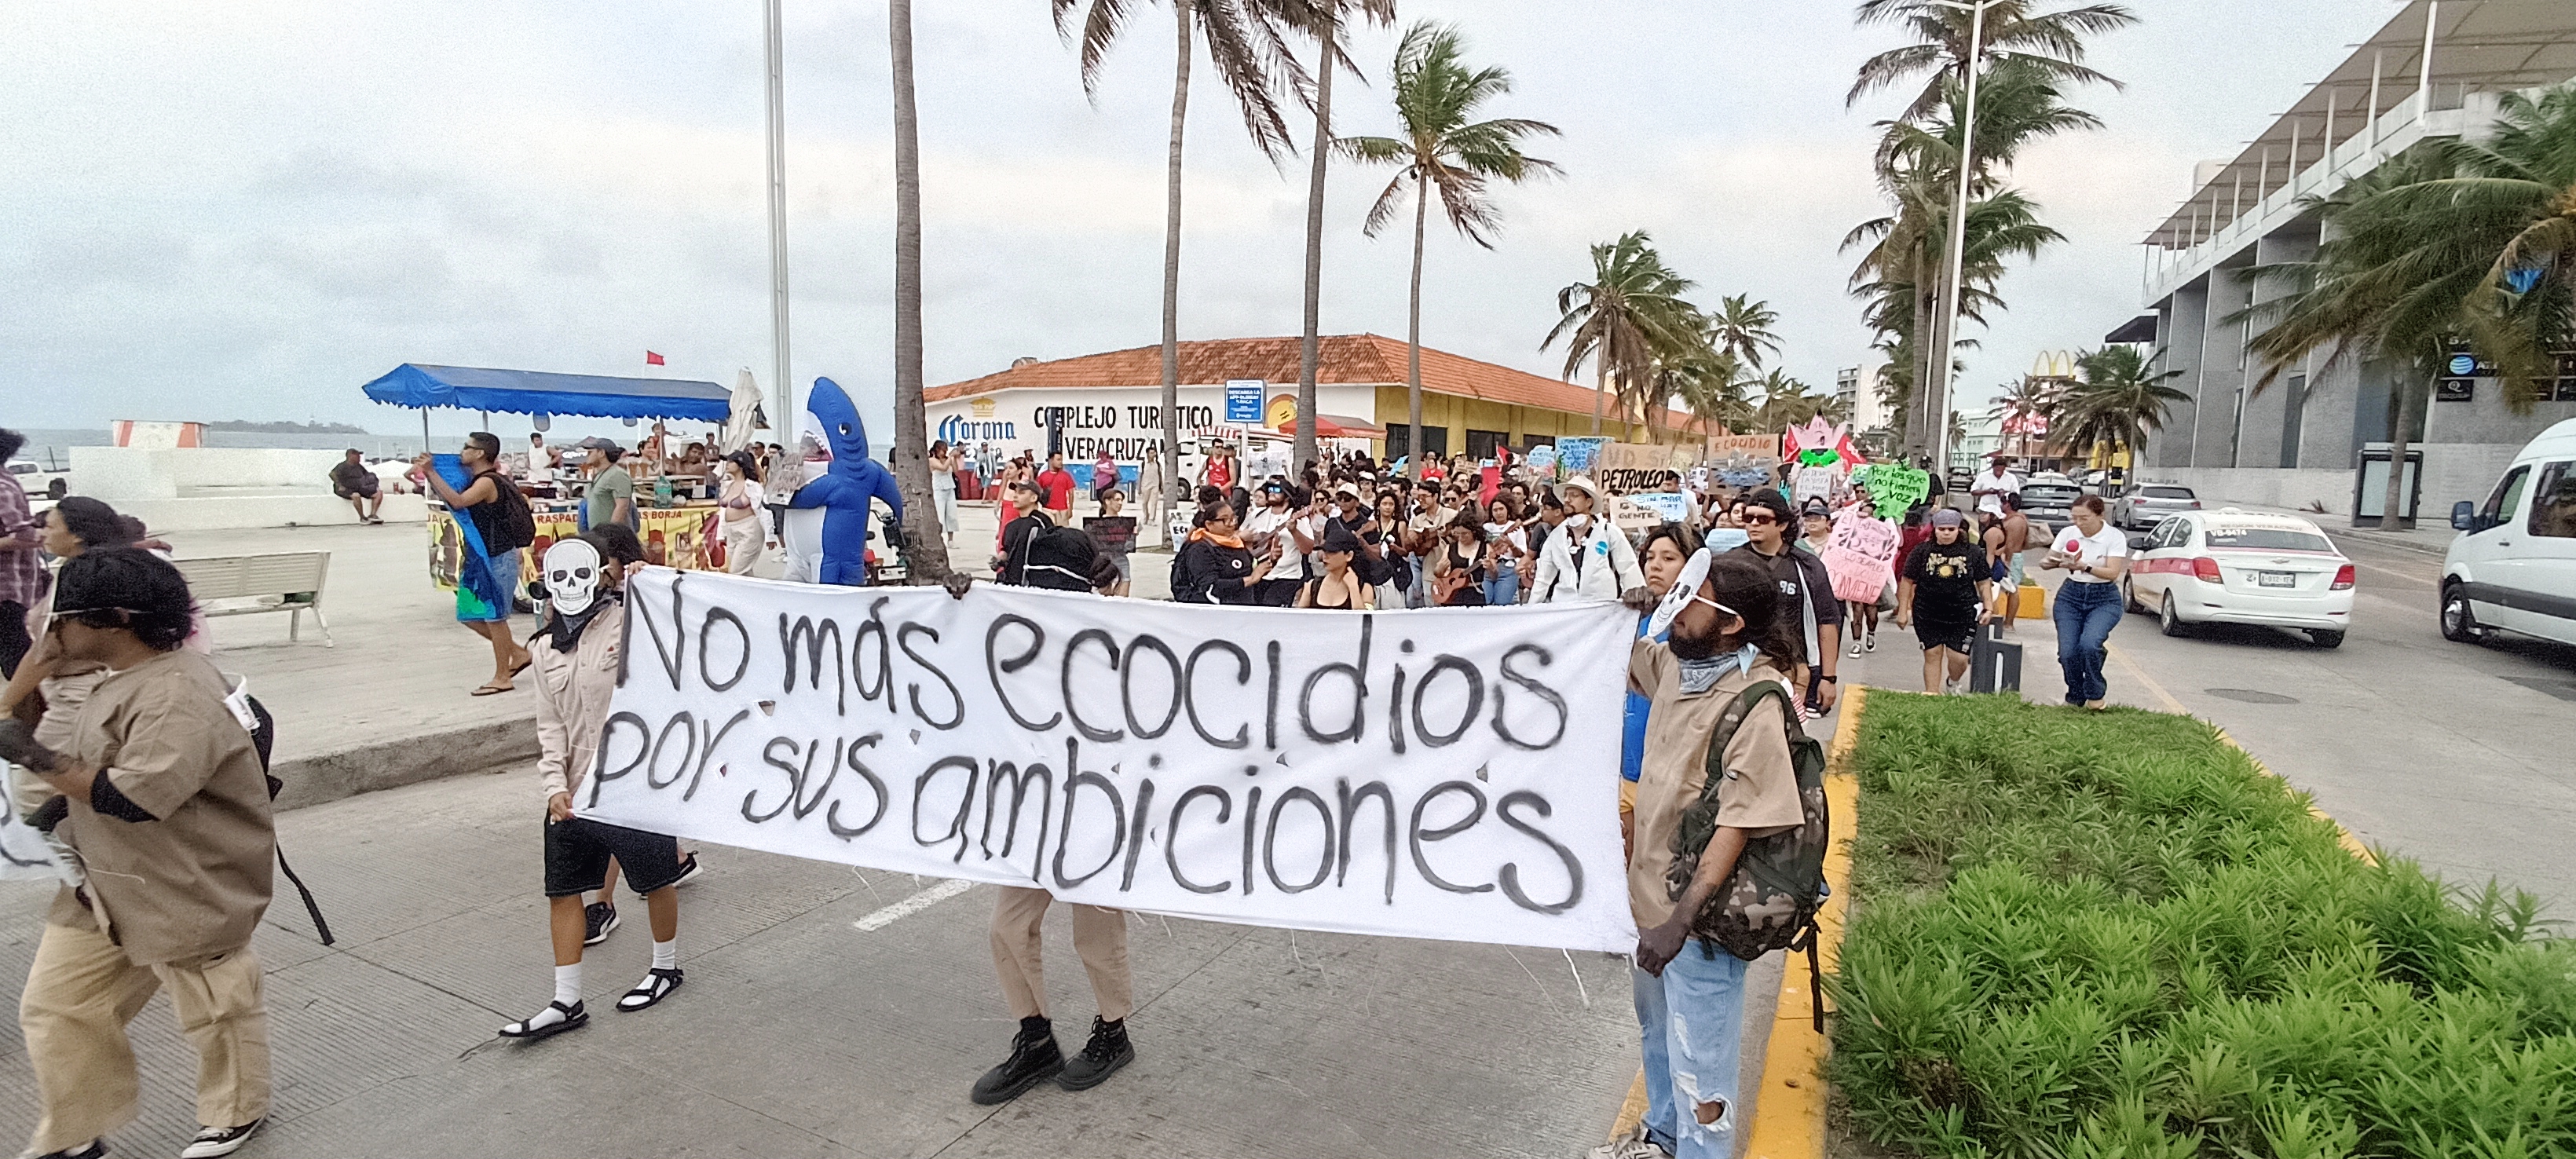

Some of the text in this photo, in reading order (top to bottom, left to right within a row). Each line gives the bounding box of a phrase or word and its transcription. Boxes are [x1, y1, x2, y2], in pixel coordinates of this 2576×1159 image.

[1128, 406, 1213, 430] TURITICO
[939, 414, 1016, 447] Corona
[1601, 469, 1665, 489] PETROLEO
[651, 510, 682, 520] BORJA
[1780, 580, 1797, 594] 96
[616, 575, 750, 691] No
[779, 597, 964, 730] más
[589, 710, 1585, 916] por sus ambiciones
